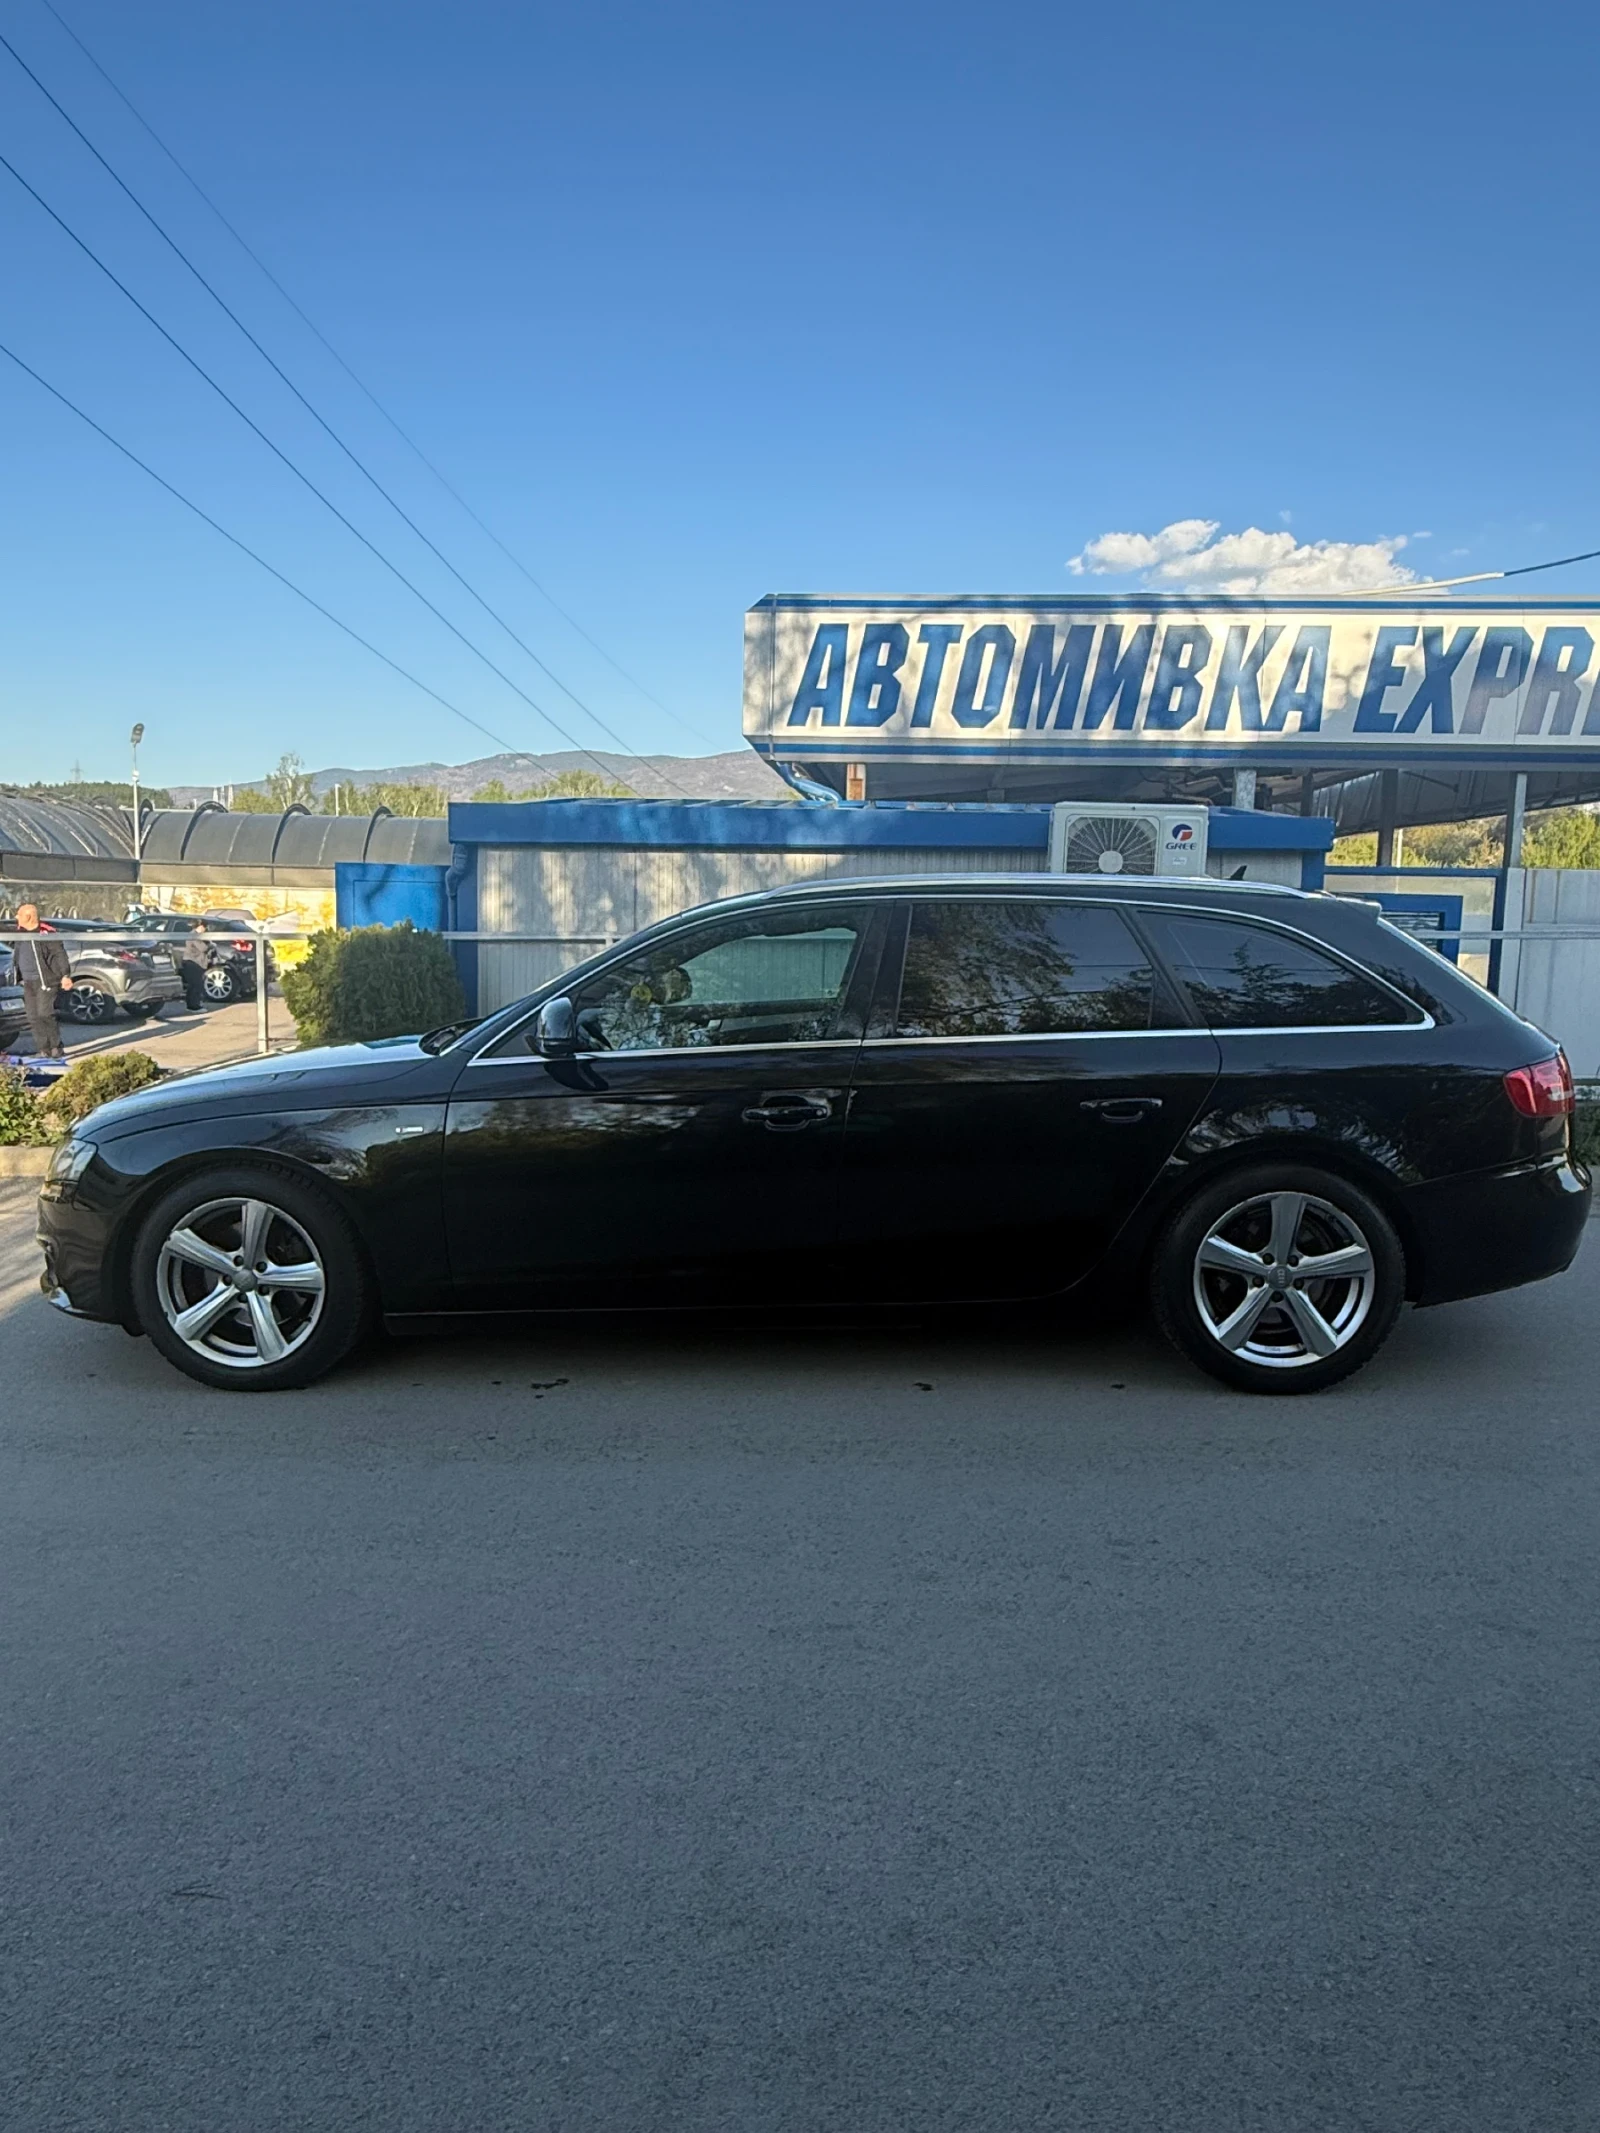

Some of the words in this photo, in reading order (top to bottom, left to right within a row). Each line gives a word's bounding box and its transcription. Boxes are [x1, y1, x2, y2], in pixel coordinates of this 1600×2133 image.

[787, 623, 1332, 732] АВТОМИВКА
[1353, 626, 1600, 736] EXPR
[1165, 842, 1197, 850] GREE
